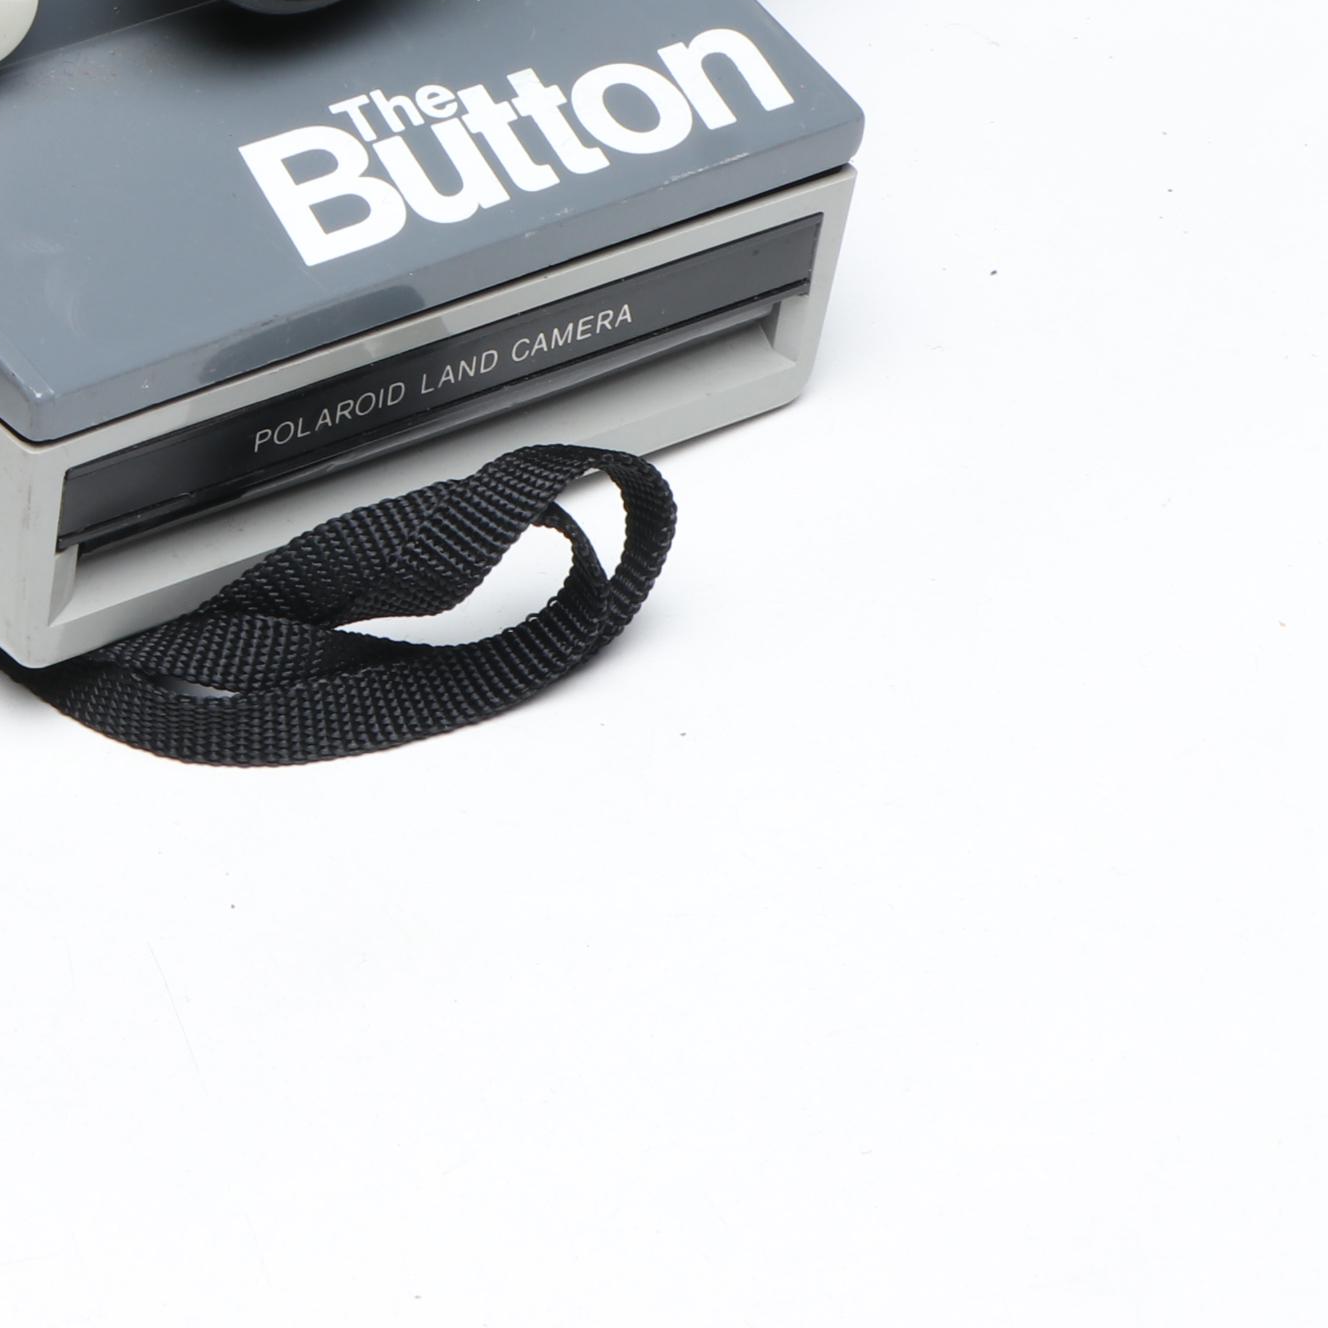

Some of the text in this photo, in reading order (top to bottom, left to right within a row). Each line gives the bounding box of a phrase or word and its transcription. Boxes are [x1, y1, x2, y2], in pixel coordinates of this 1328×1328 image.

[237, 27, 796, 268] Button
[329, 82, 459, 142] The
[252, 302, 634, 454] POLAROID LAND CAMERA
